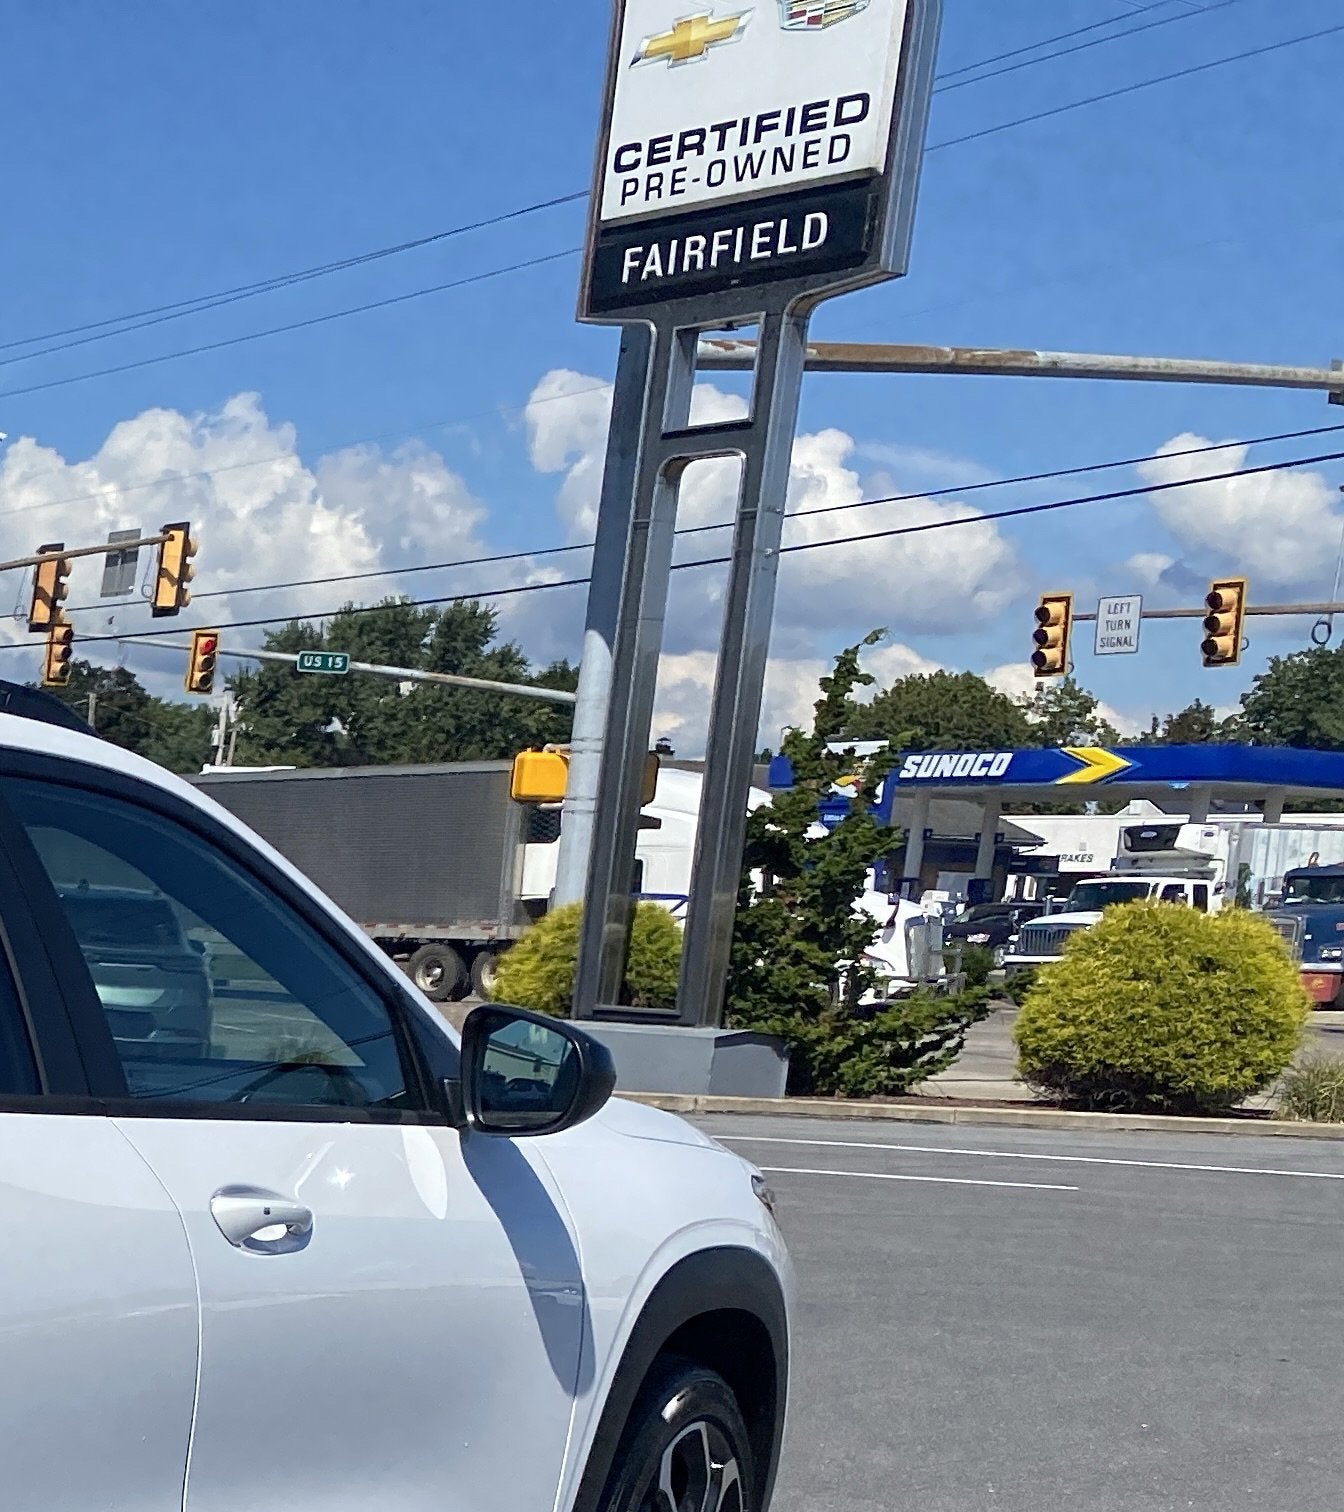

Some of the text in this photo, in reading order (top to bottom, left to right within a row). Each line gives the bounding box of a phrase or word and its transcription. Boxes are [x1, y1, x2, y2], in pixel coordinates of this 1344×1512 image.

[613, 92, 870, 174] CERTIFIED
[620, 133, 851, 206] PRE-OWNED
[621, 211, 829, 284] FAIRFIELD
[1107, 602, 1131, 615] LEFT
[1105, 620, 1131, 631] TURN
[1099, 636, 1134, 648] SIGNAL
[304, 655, 343, 668] US 15
[899, 753, 1014, 778] SUNOCO
[1060, 853, 1094, 863] RAKES
